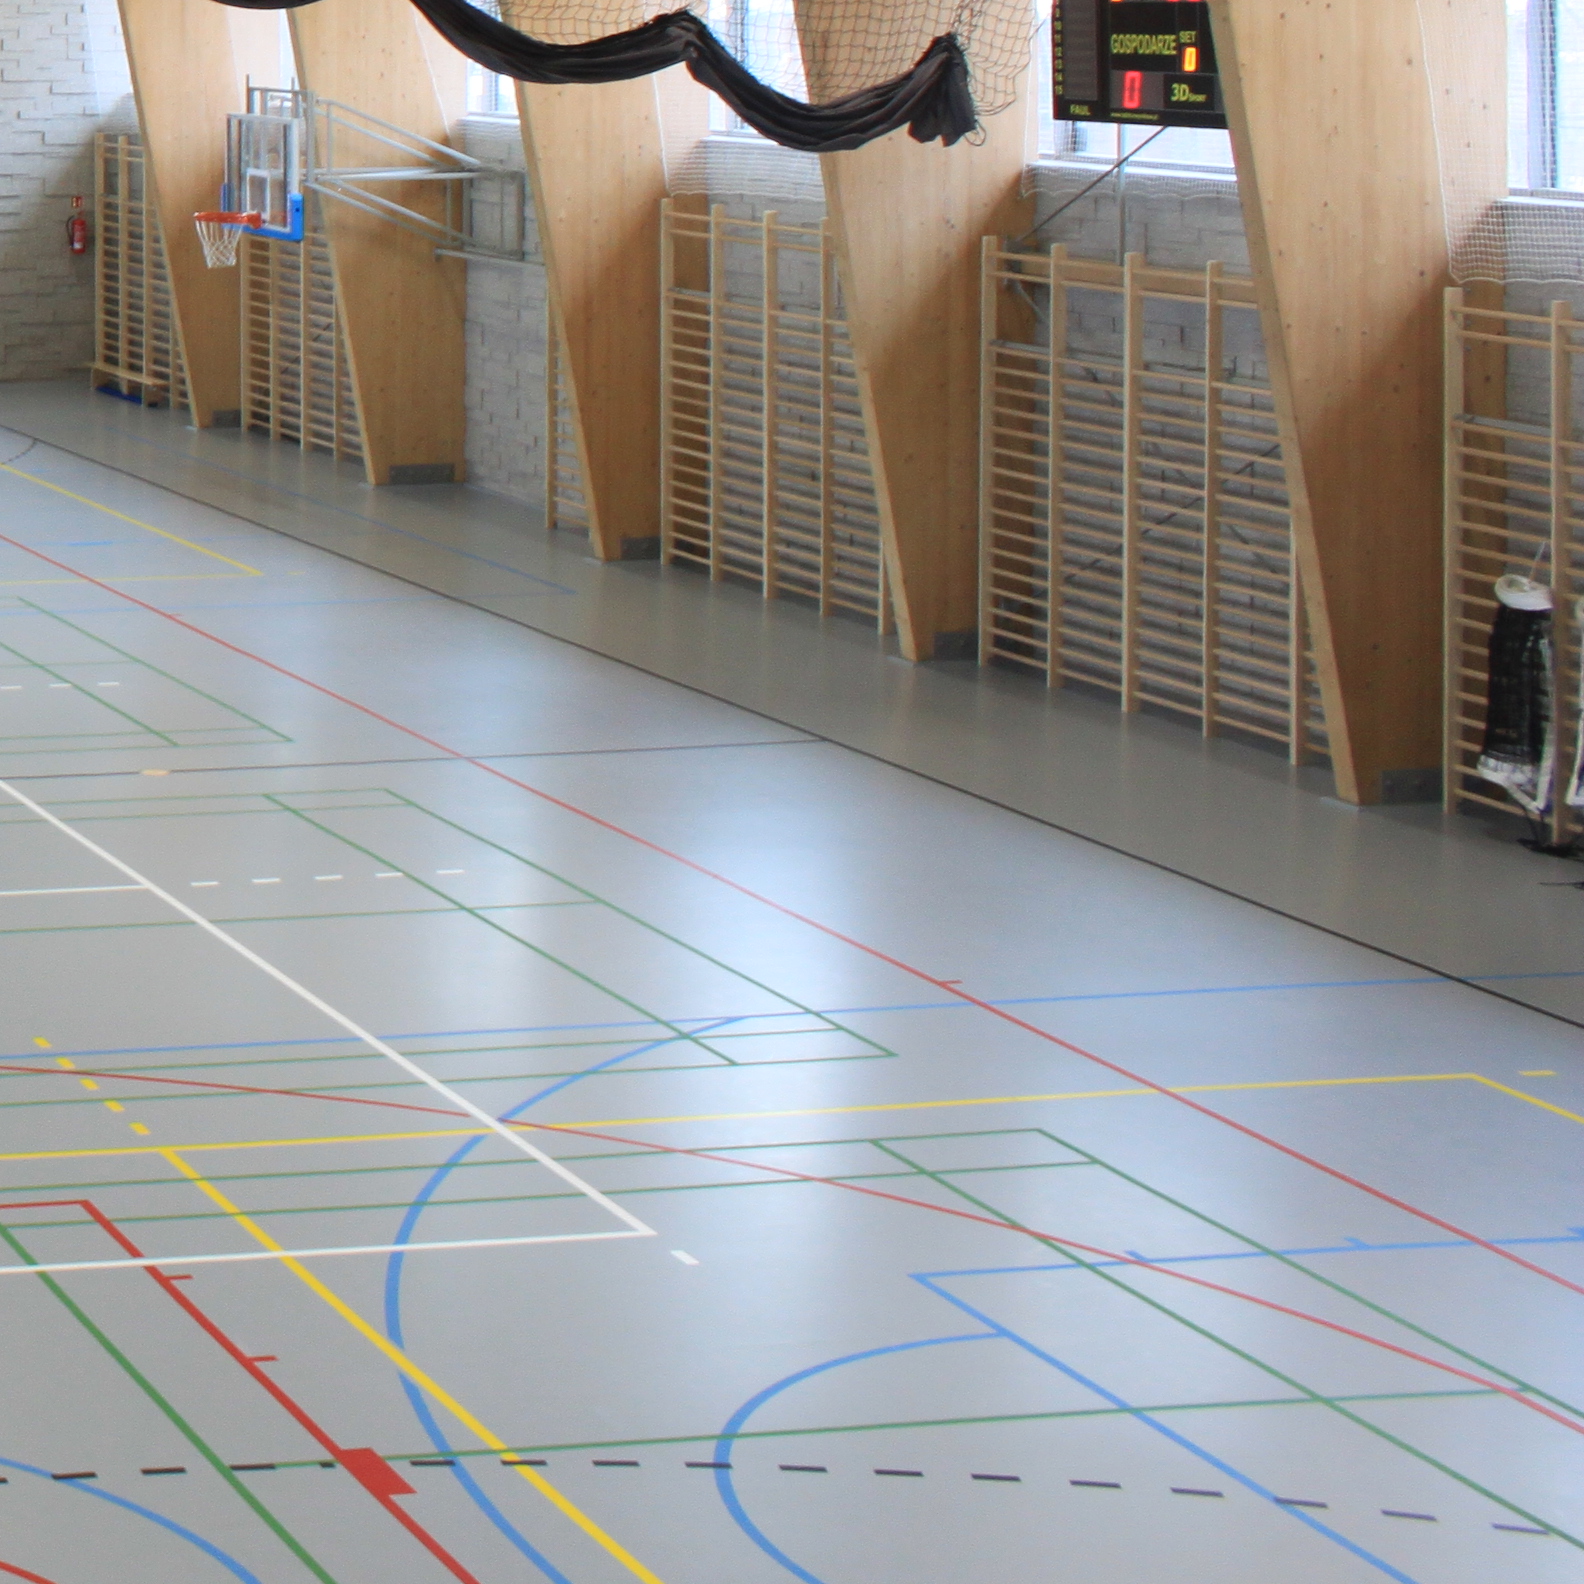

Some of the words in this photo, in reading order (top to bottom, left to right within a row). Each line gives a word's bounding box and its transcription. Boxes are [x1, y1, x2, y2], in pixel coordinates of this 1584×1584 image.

[1111, 34, 1177, 55] GOSPODARZE
[1179, 31, 1196, 43] SET
[1183, 46, 1198, 72] 0
[1123, 70, 1142, 109] 0
[1170, 83, 1189, 102] 3D
